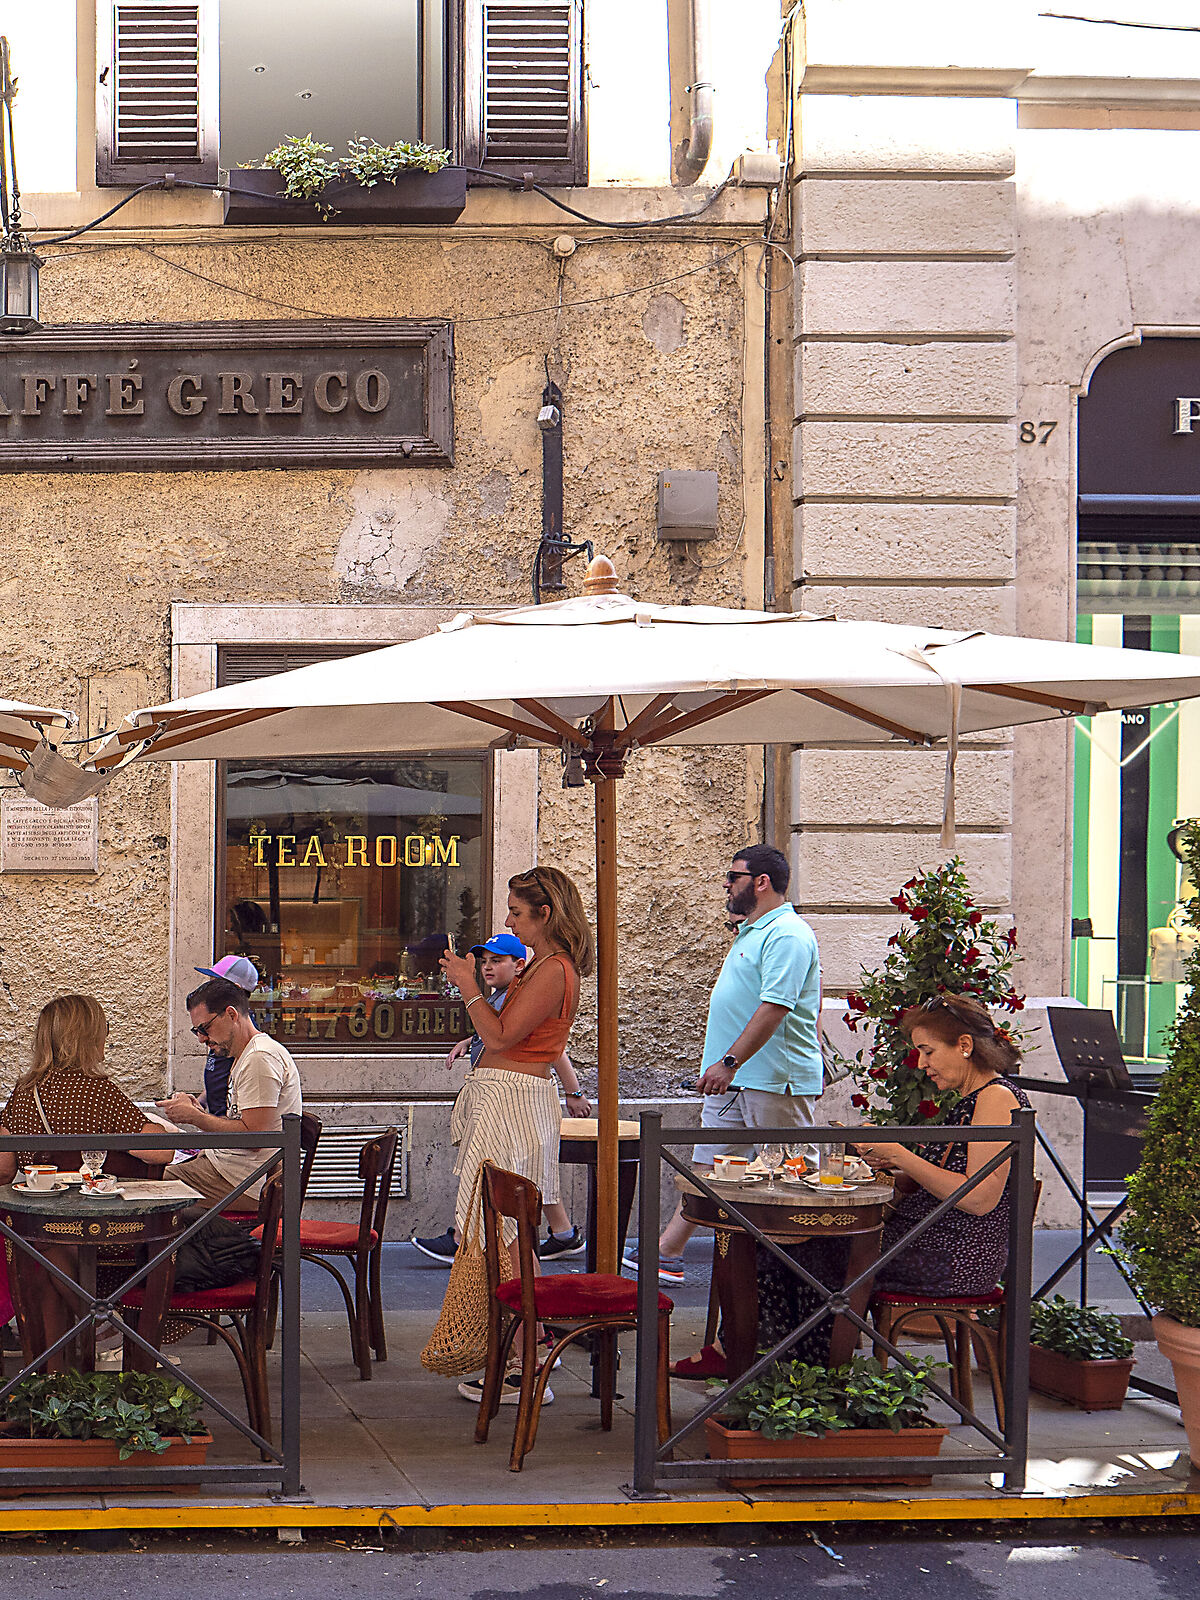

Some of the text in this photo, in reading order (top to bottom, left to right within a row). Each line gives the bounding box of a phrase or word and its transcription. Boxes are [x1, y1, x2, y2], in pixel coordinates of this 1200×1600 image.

[167, 368, 391, 416] GRECO
[1019, 420, 1058, 444] 87
[249, 834, 461, 868] TEA ROOM
[308, 1002, 395, 1040] 1760
[402, 1007, 475, 1035] GREC
